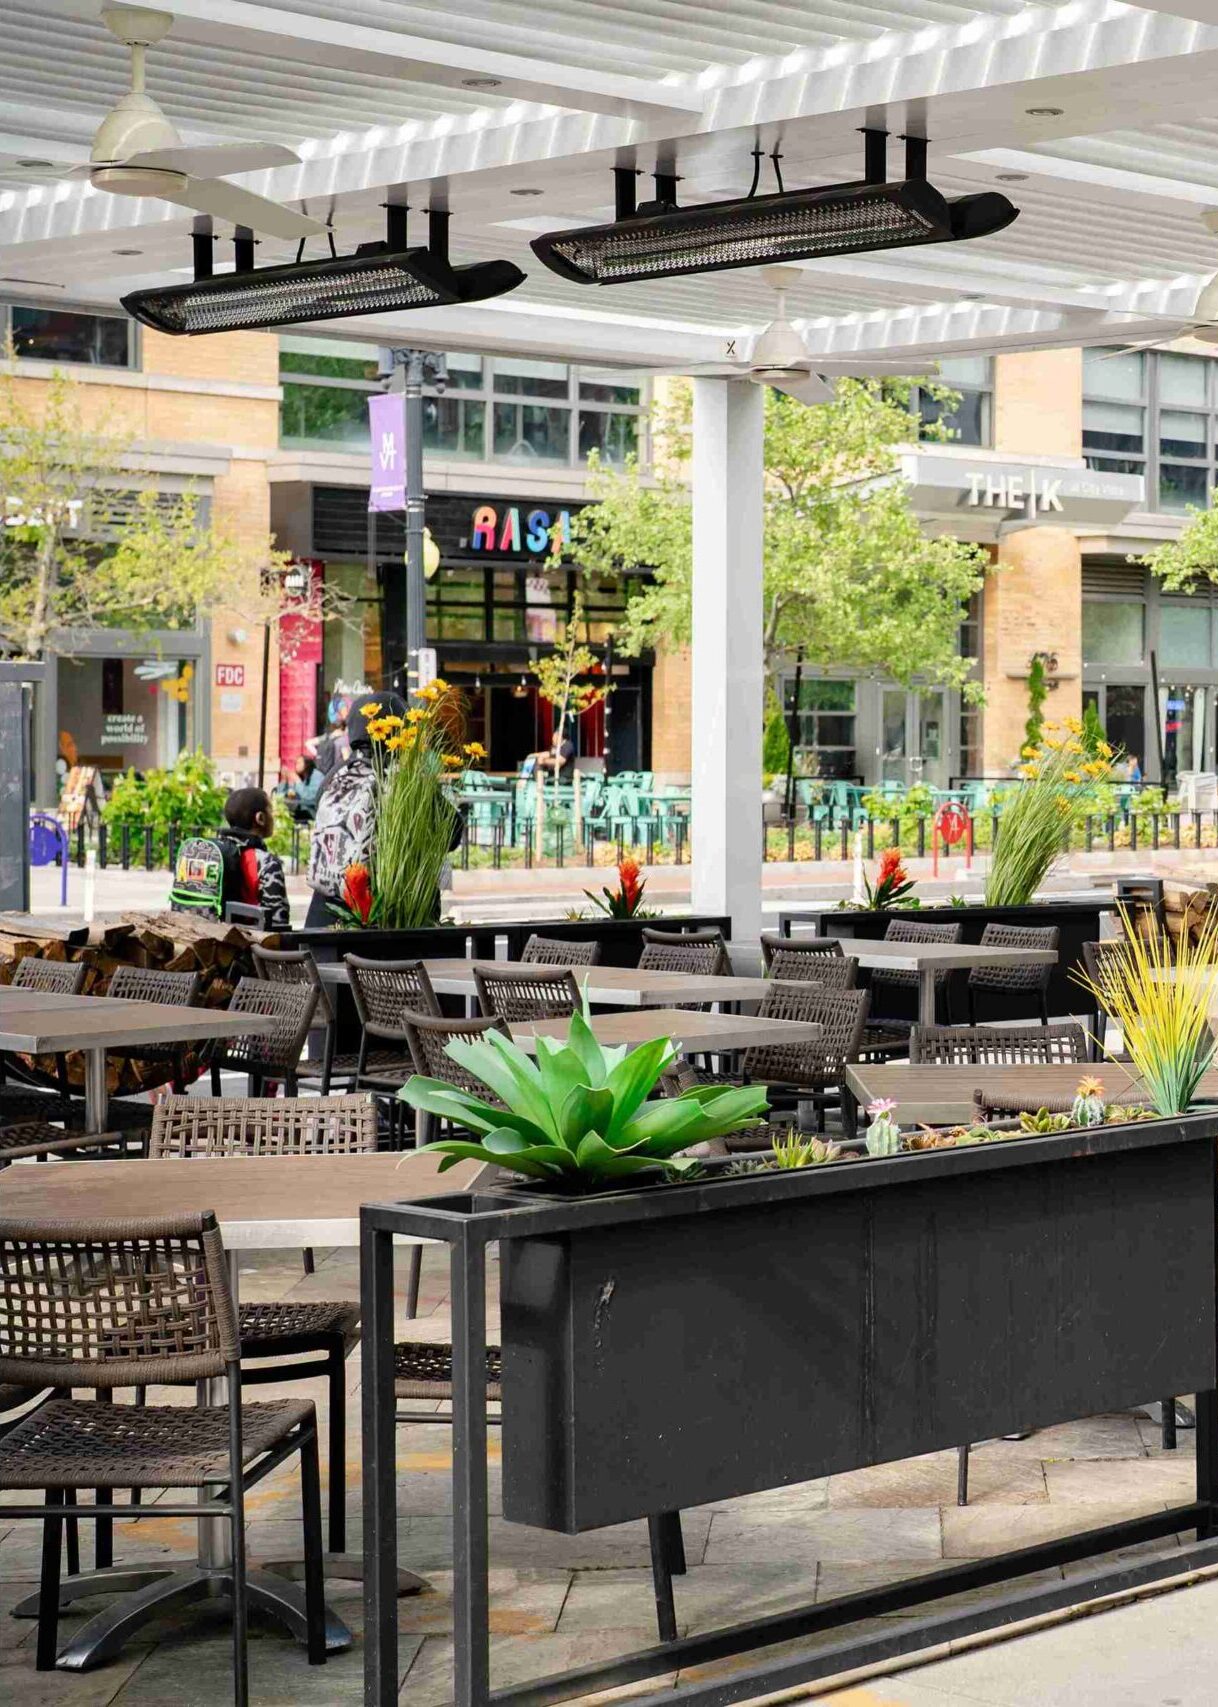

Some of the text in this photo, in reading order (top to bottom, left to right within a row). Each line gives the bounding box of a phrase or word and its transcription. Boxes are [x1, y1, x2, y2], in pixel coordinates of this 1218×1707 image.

[471, 505, 571, 556] RASA
[217, 666, 243, 685] FDC
[106, 724, 134, 733] world
